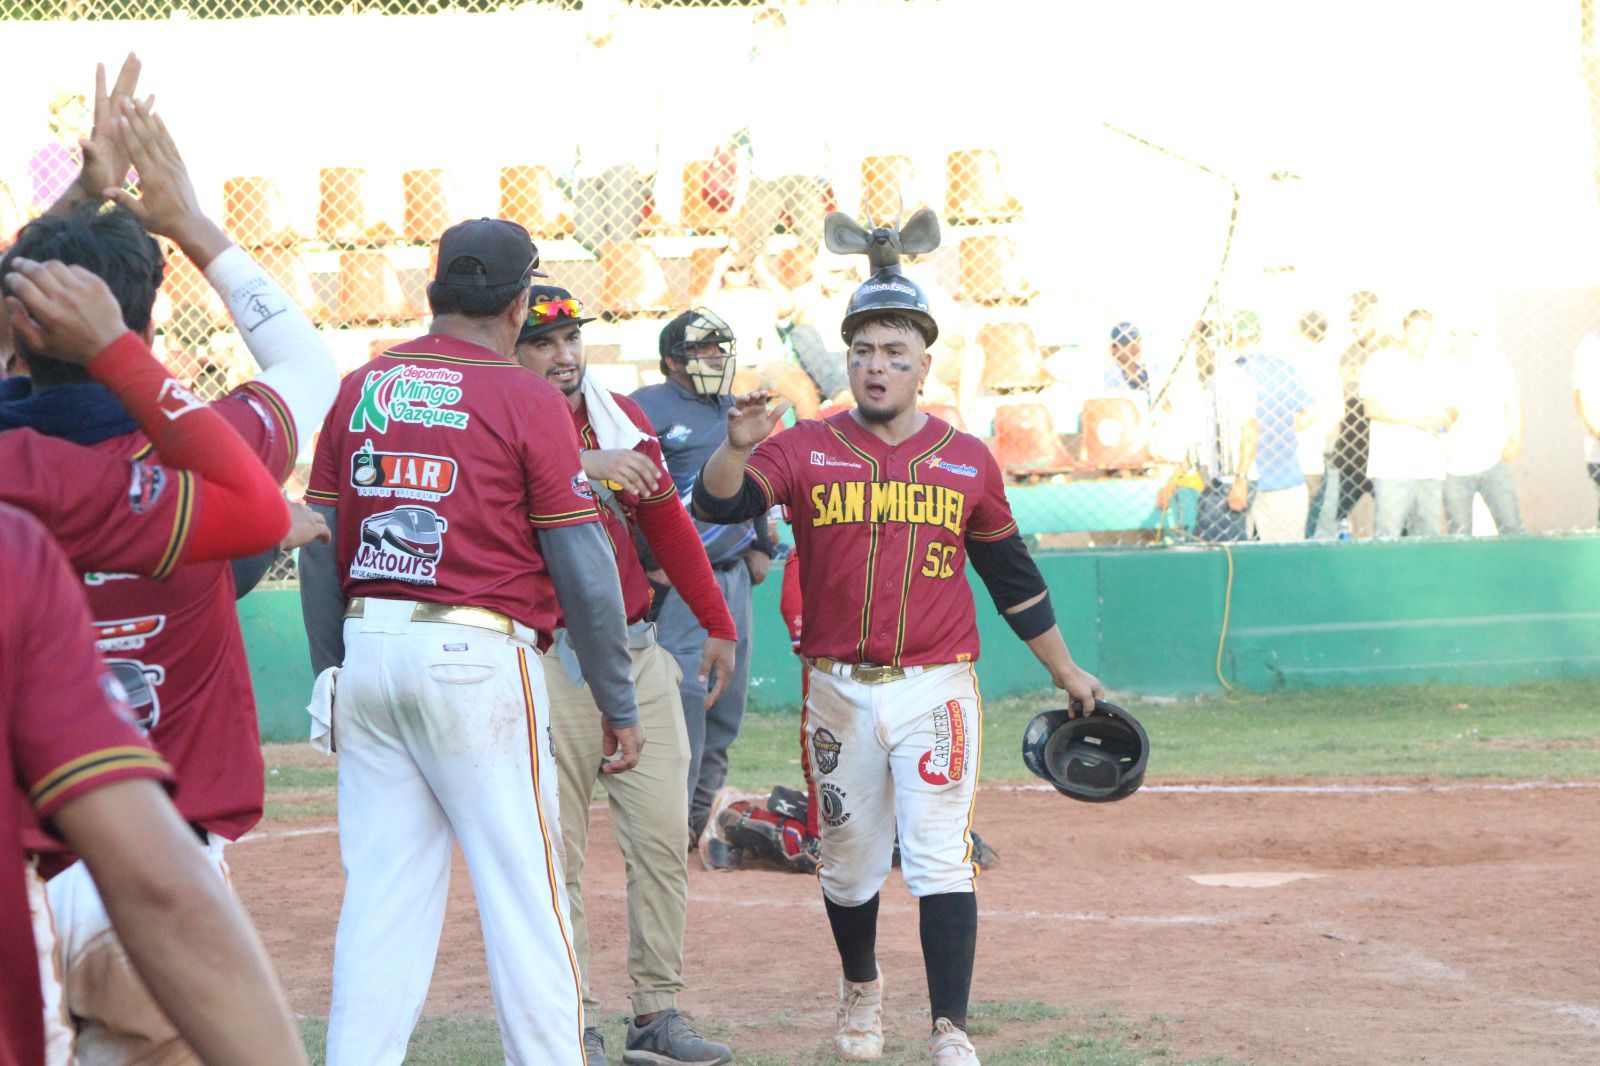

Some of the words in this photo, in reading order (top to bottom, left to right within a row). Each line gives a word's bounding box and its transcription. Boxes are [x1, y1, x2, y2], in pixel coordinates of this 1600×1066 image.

[403, 367, 460, 382] deportivo
[393, 380, 460, 406] Mingo
[390, 401, 467, 427] Vazquez
[388, 458, 442, 489] JAR
[811, 481, 866, 529] SAN
[869, 480, 965, 537] MIGUEL
[950, 701, 965, 757] Francisco
[949, 757, 963, 780] San
